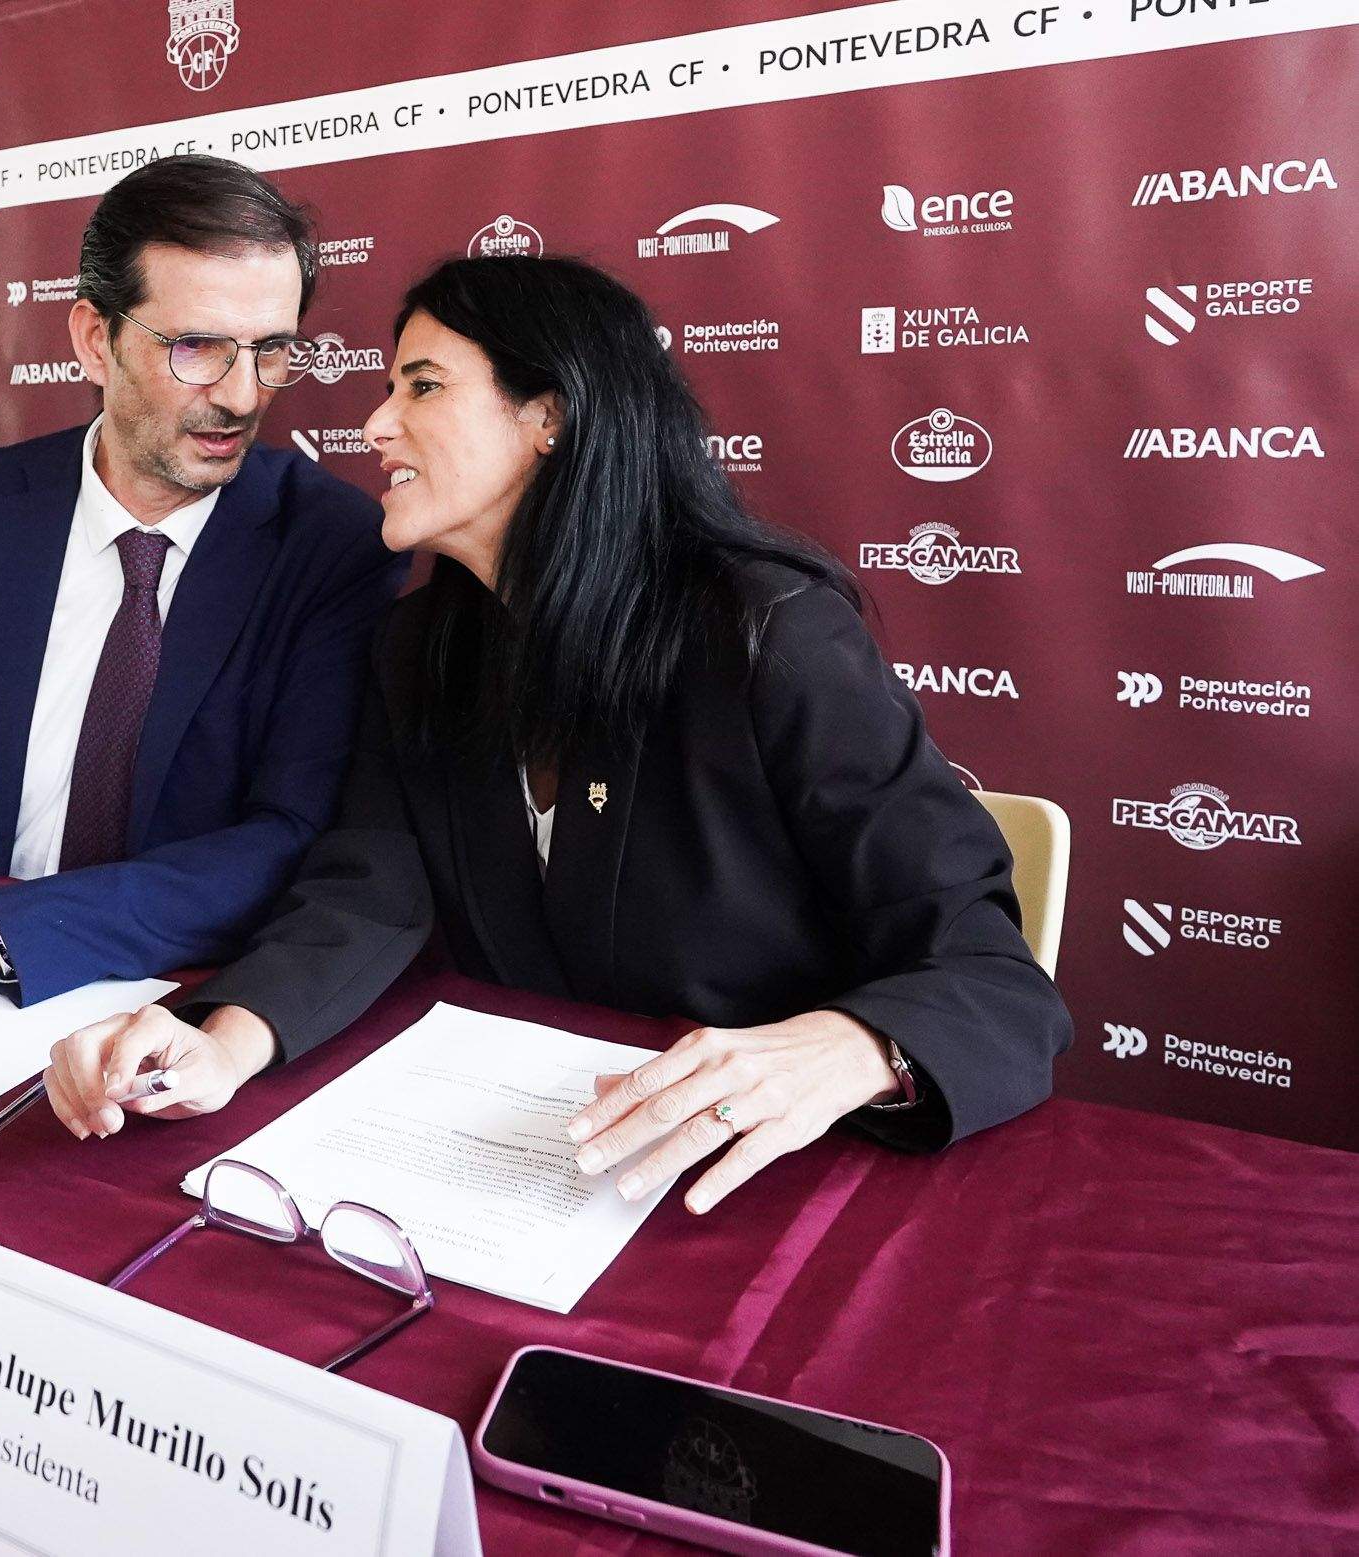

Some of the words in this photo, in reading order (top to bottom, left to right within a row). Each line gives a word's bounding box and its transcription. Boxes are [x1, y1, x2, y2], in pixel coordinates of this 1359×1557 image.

[38, 146, 160, 181] PONTEVEDRA
[232, 111, 380, 152] PONTEVEDRA
[393, 104, 423, 128] CF
[468, 69, 650, 118] PONTEVEDRA
[669, 61, 704, 88] CF
[760, 18, 990, 75] PONTEVEDRA
[1014, 6, 1059, 37] CF
[921, 188, 1014, 224] ence
[923, 224, 960, 237] ENERGÍA
[971, 221, 1013, 233] CELULOSA
[318, 236, 374, 254] DEPORTE
[480, 233, 531, 250] Estrella
[637, 230, 730, 258] VISIT-PONTEVEDRA.GAL
[319, 251, 369, 267] GALEGO
[32, 274, 81, 292] Deputació
[1206, 279, 1313, 299] DEPORTE
[903, 306, 980, 327] XUNTA
[1205, 297, 1301, 317] GALEGO
[684, 319, 779, 341] Deputación
[902, 329, 933, 348] DE
[937, 325, 1029, 347] GALICIA
[684, 337, 779, 353] Pontevedra
[302, 348, 385, 371] CAMAR
[322, 429, 363, 441] DEPOR
[908, 429, 975, 449] Estrella
[322, 441, 372, 453] GALEGO
[703, 434, 763, 460] nce
[910, 447, 972, 466] Galicia
[860, 544, 1022, 573] PESCAMAR
[1126, 571, 1254, 599] VISIT-PONTEVEDRA.GAL
[893, 663, 1019, 699] BANCA
[1179, 675, 1311, 700] Deputación
[1179, 693, 1310, 718] Pontevedra
[1112, 798, 1302, 845] PESCAMAR
[1181, 908, 1282, 934] DEPORTE
[1179, 924, 1270, 950] GALEGO
[1164, 1034, 1293, 1072] Deputación
[1163, 1051, 1291, 1088] Pontevedra
[84, 1387, 227, 1485] Murillo
[238, 1453, 337, 1533] Solís
